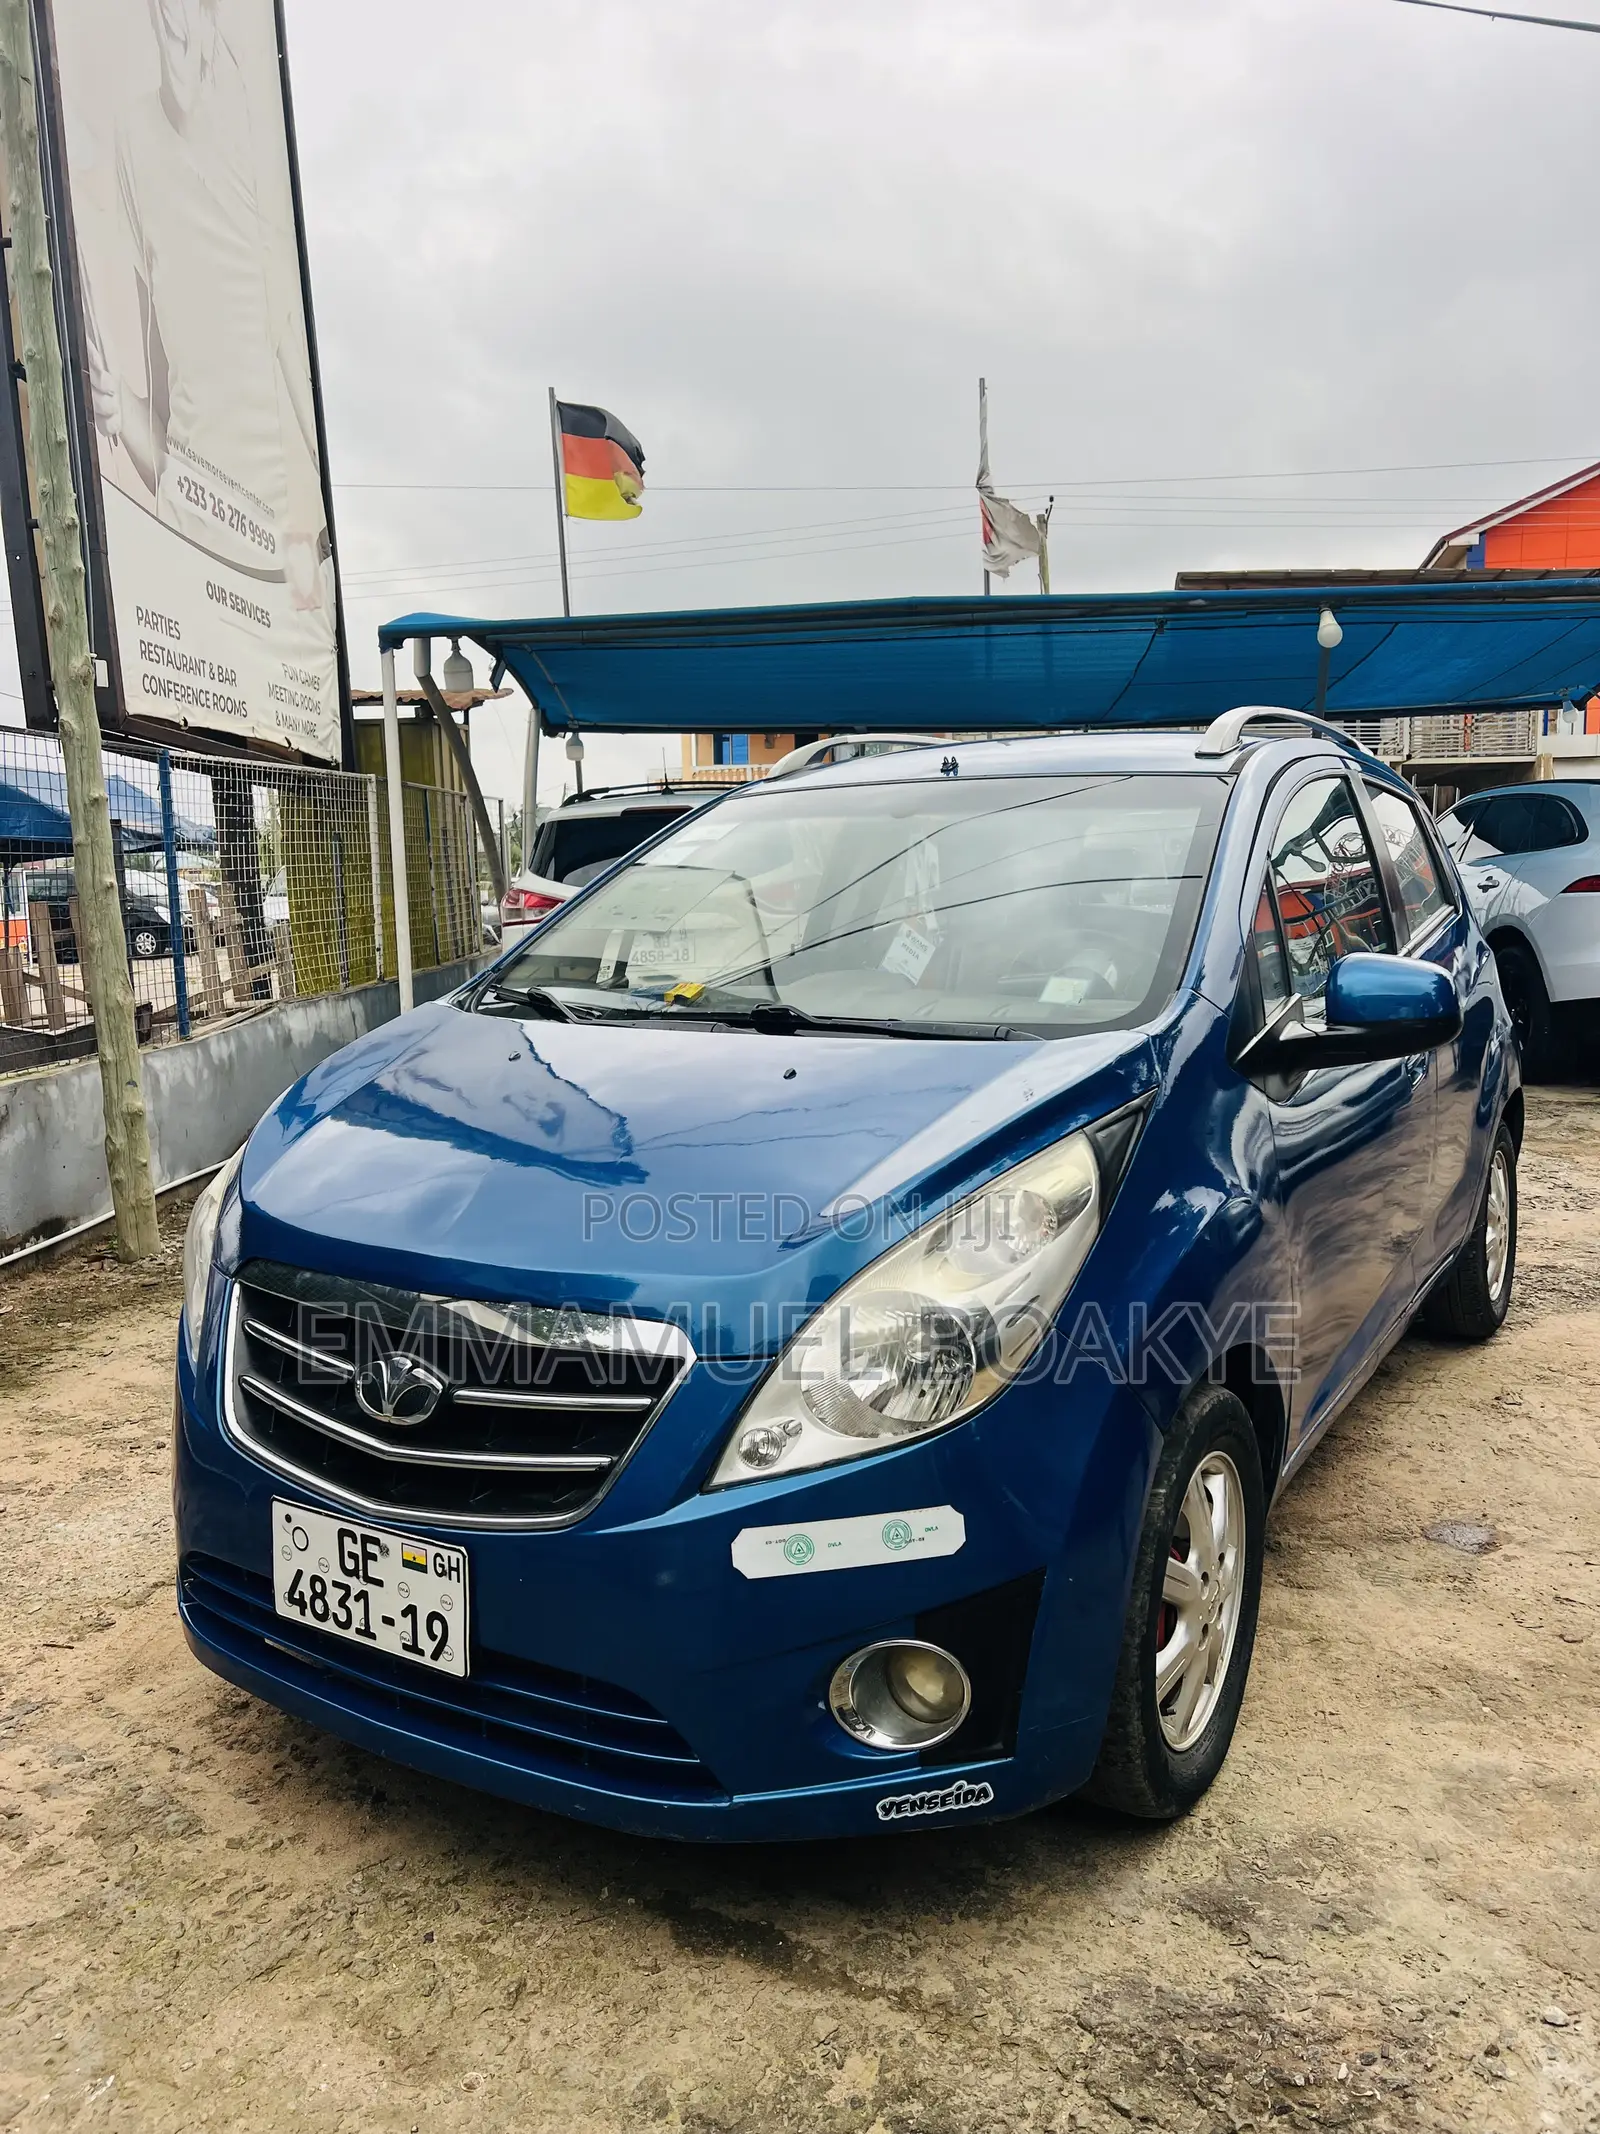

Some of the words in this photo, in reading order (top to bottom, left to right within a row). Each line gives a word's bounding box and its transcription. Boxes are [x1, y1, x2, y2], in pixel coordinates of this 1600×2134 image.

[177, 475, 208, 511] +233
[208, 492, 226, 522] 26
[227, 503, 247, 537] 276
[248, 519, 276, 555] 9999
[206, 580, 228, 607] OUR
[229, 591, 272, 629] SERVICES
[135, 605, 182, 640] PARTIES
[139, 639, 207, 678] RESTAURANT
[208, 663, 216, 681] &
[217, 665, 238, 688] BAR
[281, 662, 299, 683] FUN
[299, 668, 321, 691] GAMES
[142, 673, 211, 710] CONFERENCE
[213, 693, 248, 719] ROOMS
[267, 681, 300, 708] MEETING
[300, 692, 321, 716] ROOMS
[275, 710, 281, 727] &
[281, 711, 300, 733] MANY
[631, 948, 690, 964] 4858-18
[901, 942, 920, 960] MEDIA
[337, 1527, 384, 1588] GE
[433, 1552, 461, 1584] GH
[827, 1541, 842, 1549] DVLA
[287, 1568, 450, 1662] 4831-19
